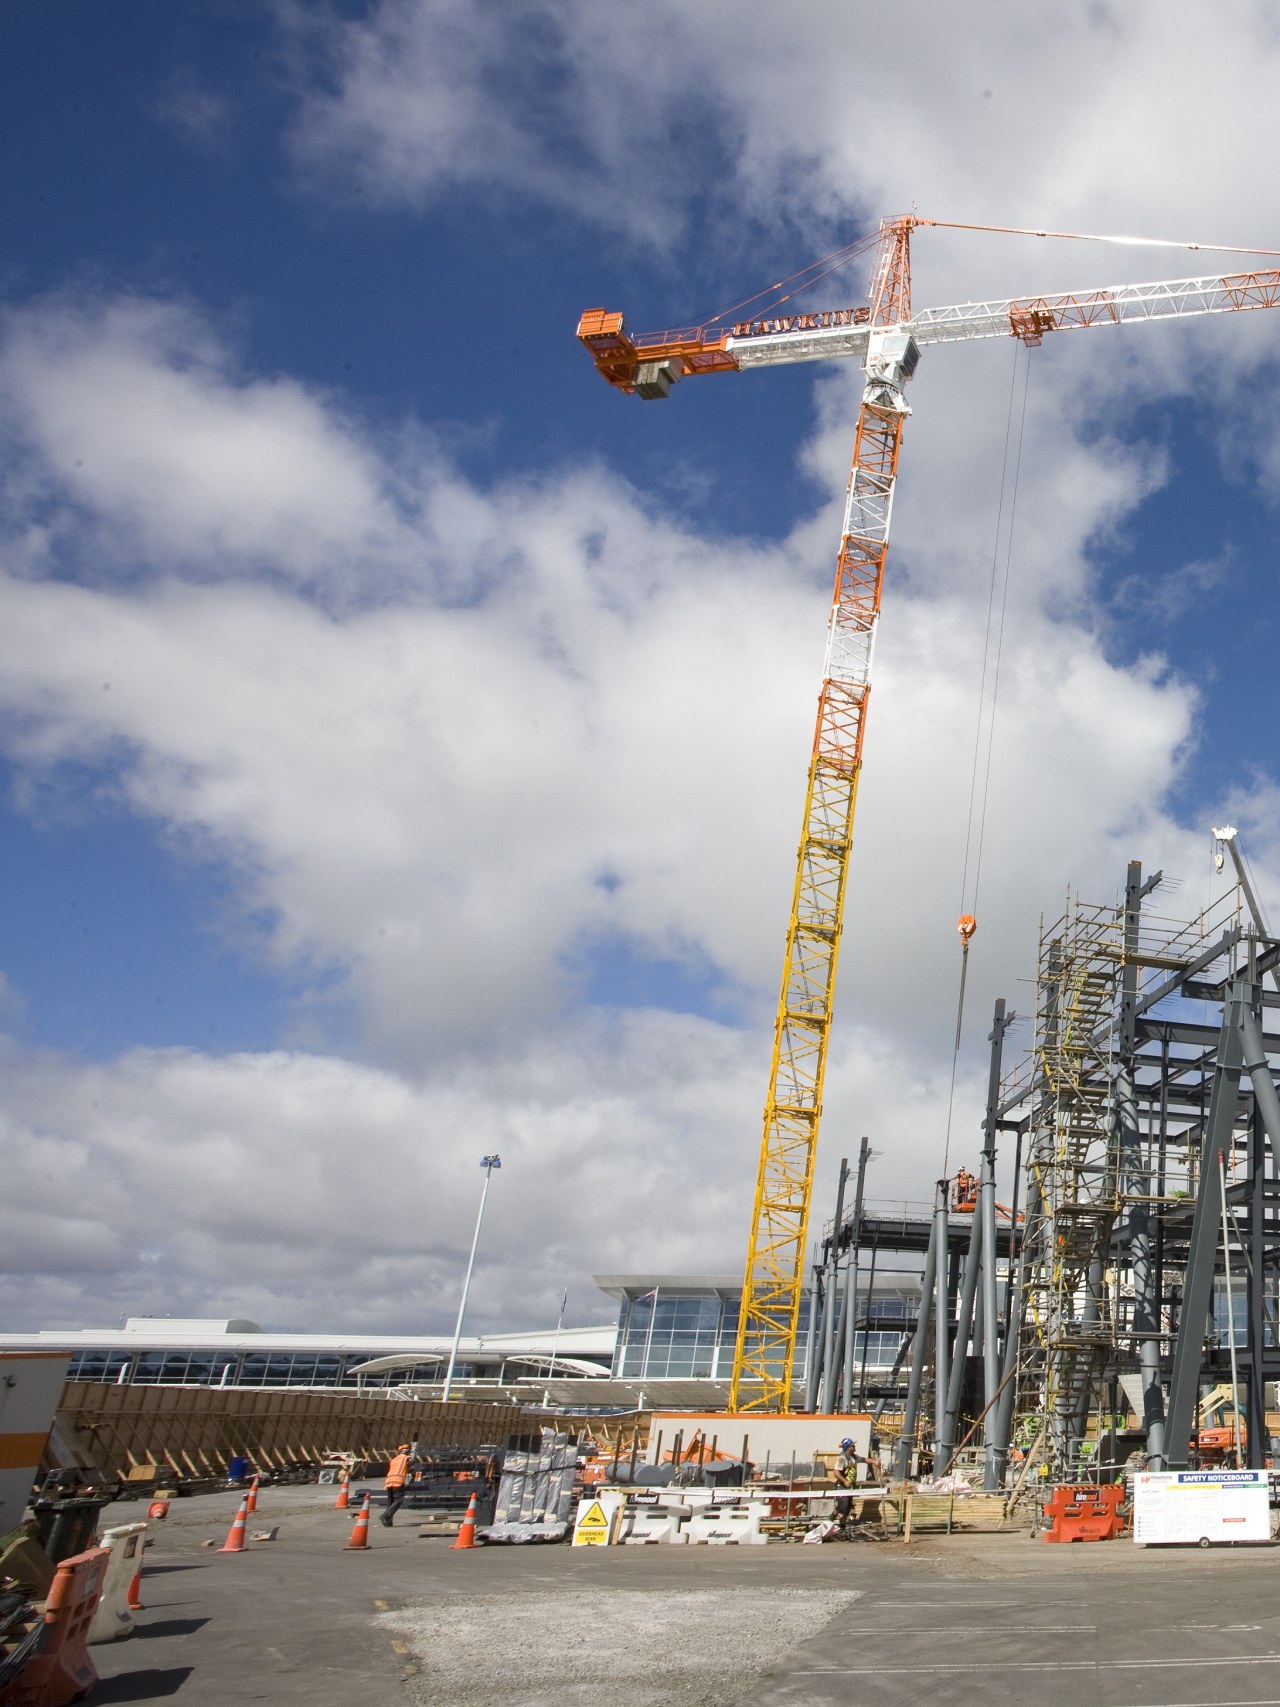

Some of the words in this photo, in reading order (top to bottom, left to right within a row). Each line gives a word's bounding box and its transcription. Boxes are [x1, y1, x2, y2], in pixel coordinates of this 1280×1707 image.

[732, 307, 870, 336] HAWKINS
[1183, 1474, 1205, 1482] SAFETY
[1208, 1473, 1254, 1482] NOTICEBOARD
